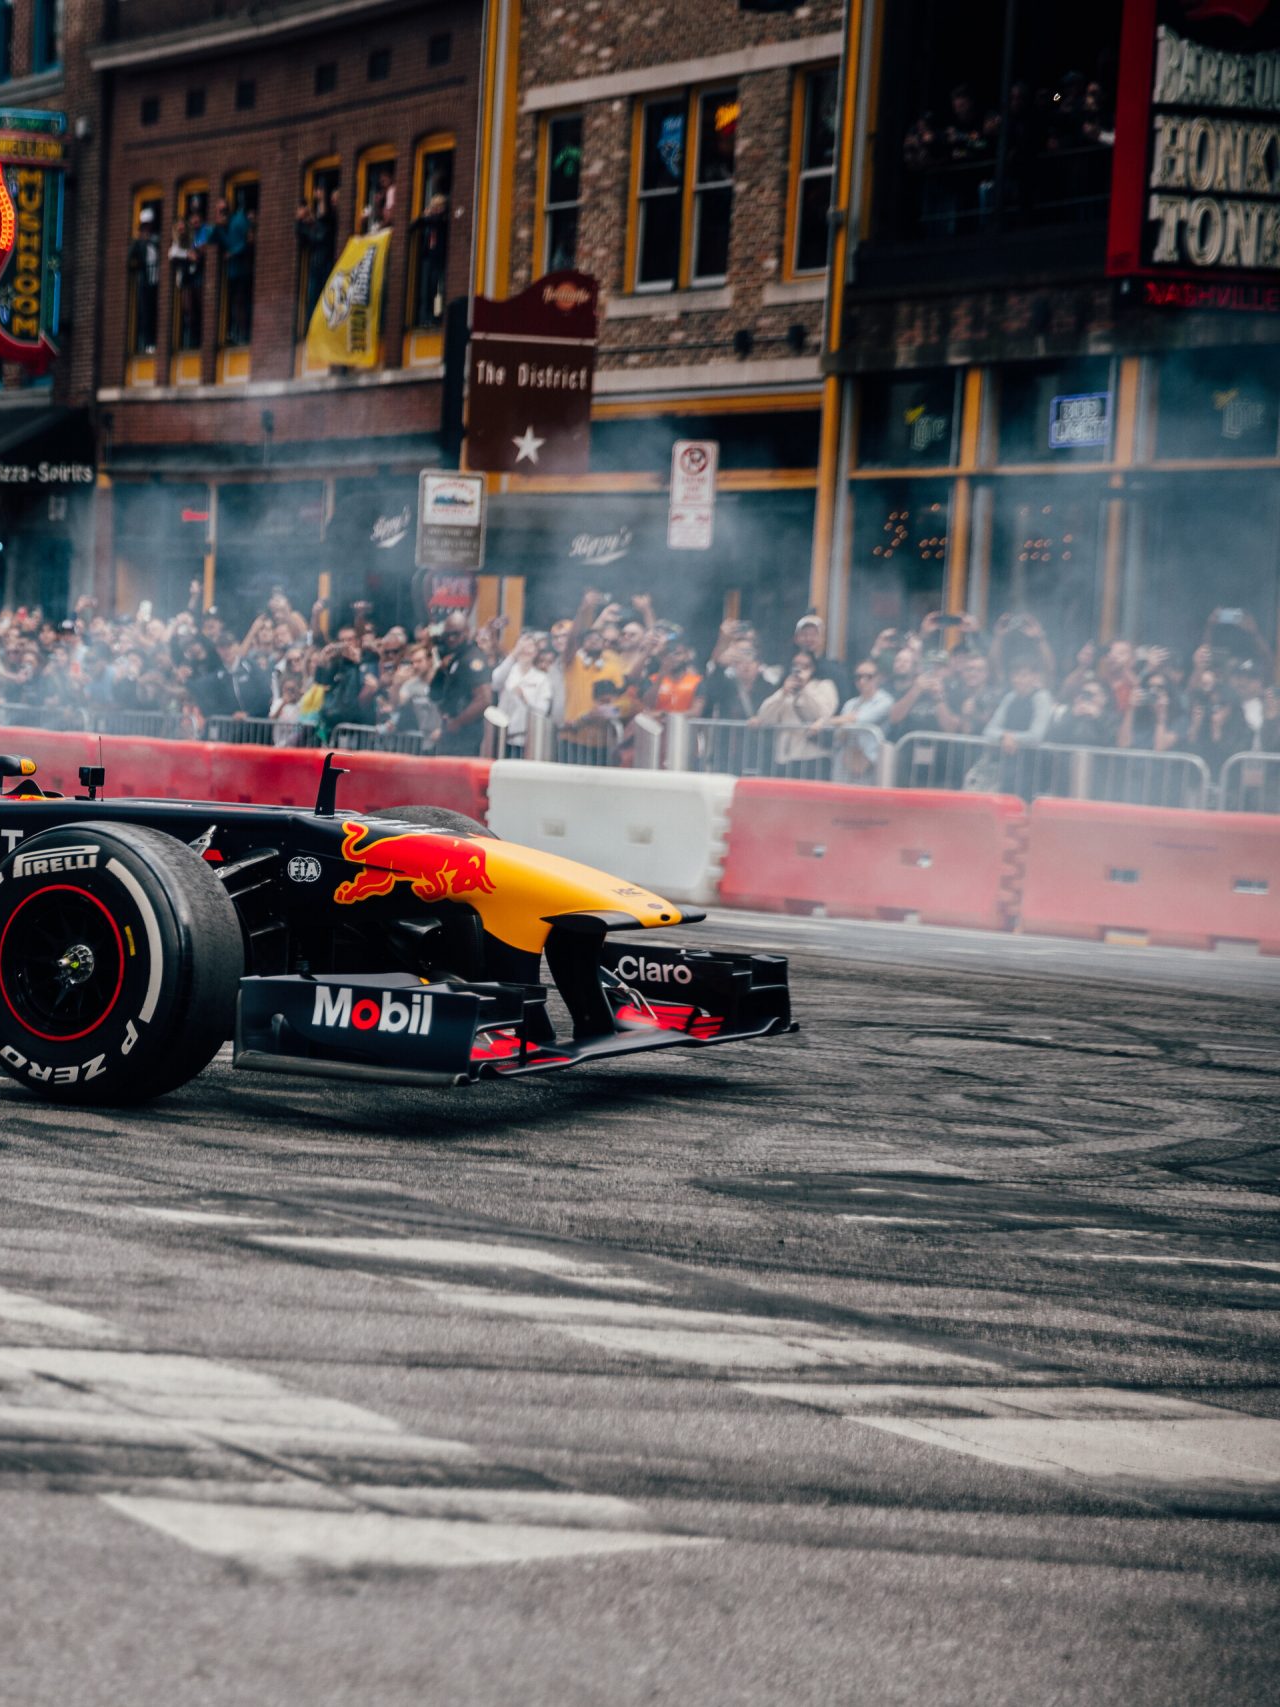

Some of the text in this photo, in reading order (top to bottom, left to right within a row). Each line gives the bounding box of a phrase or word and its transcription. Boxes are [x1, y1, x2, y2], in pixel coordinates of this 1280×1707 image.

[1151, 115, 1280, 192] HONK
[476, 361, 588, 391] The District
[13, 845, 100, 878] PIRELLI
[290, 860, 318, 877] FIA
[617, 955, 693, 985] Claro
[312, 986, 432, 1034] Mobil
[0, 1020, 158, 1085] P ZERO
